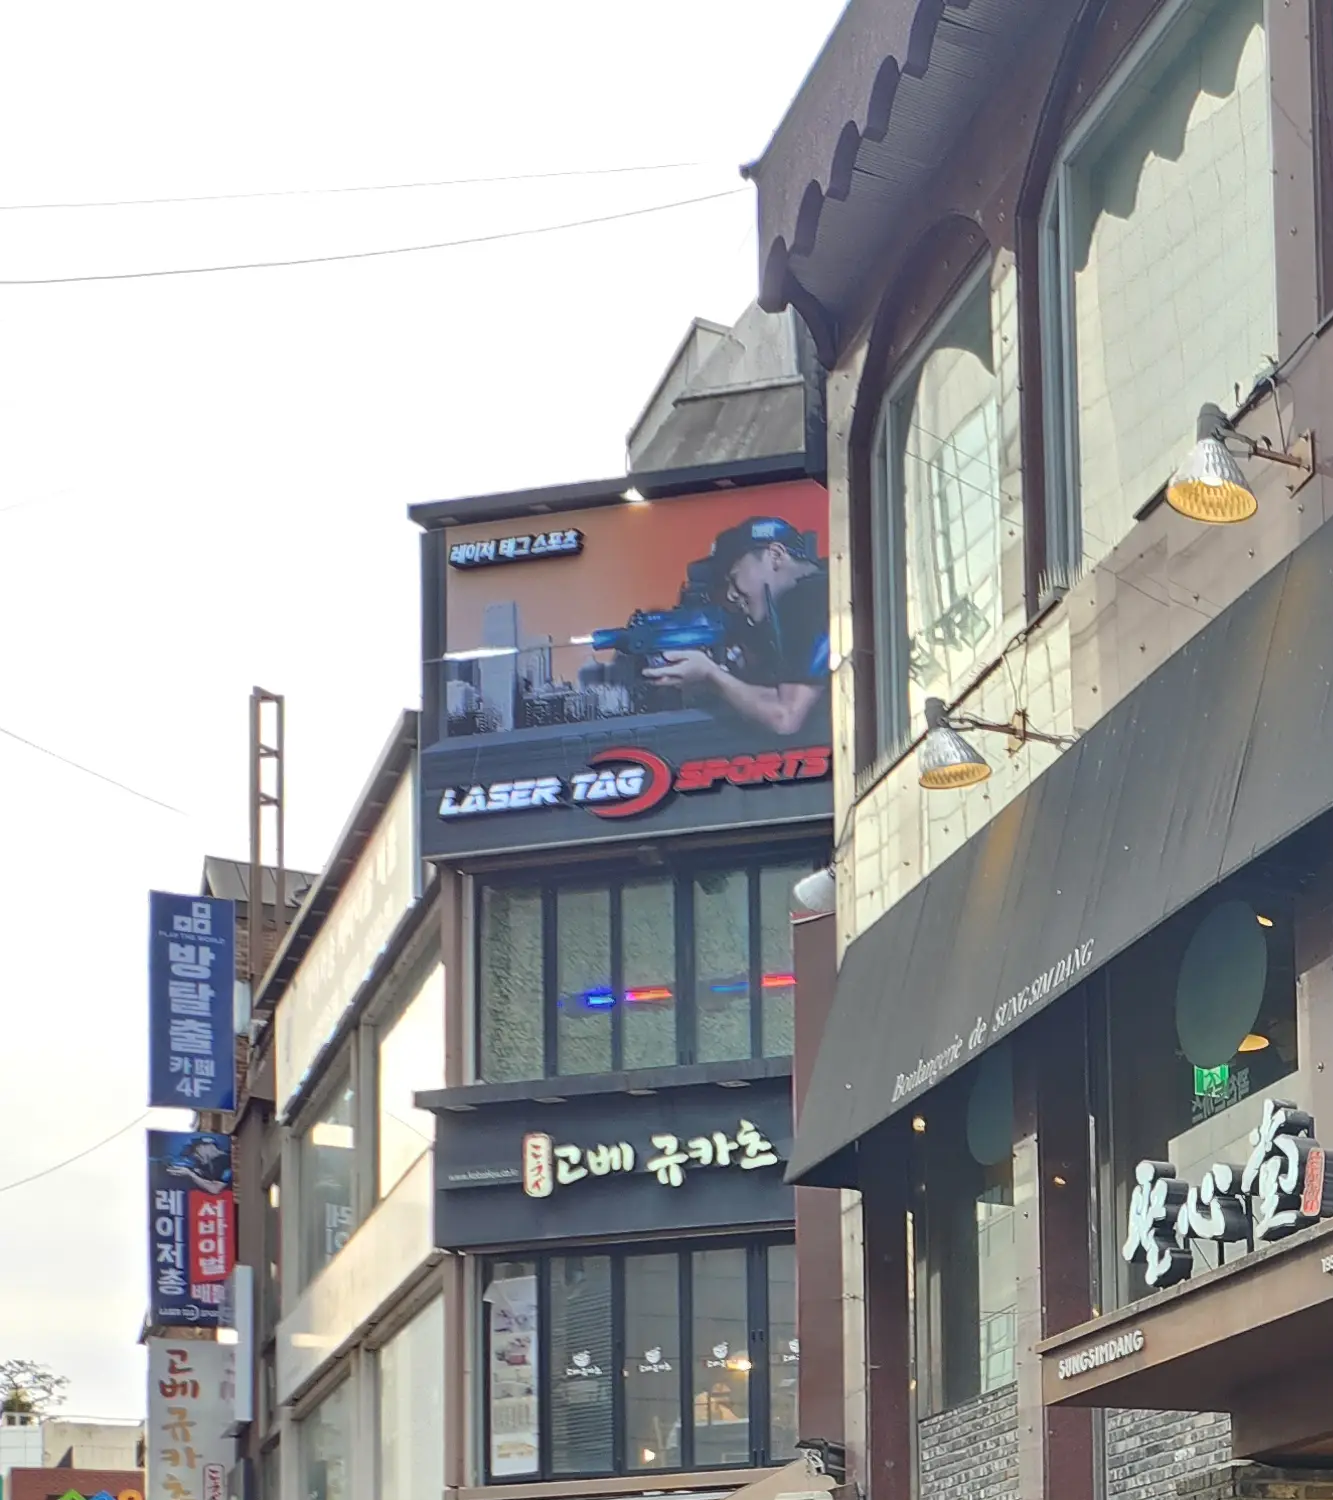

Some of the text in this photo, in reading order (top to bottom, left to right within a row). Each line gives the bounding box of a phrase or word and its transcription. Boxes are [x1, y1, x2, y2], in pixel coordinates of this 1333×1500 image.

[450, 530, 578, 564] 레이저 태그 스포츠
[438, 746, 832, 817] LASER TAG SPORTS
[168, 941, 215, 1056] 방탈출
[169, 1056, 215, 1078] 카페
[175, 1078, 214, 1099] 4F
[891, 1034, 964, 1103] Boulangerie
[967, 1016, 988, 1050] de
[552, 1141, 635, 1186] 고베
[646, 1119, 779, 1188] 규카츠
[155, 1188, 187, 1297] 레이저총
[158, 1348, 199, 1400] 고베
[1057, 1329, 1145, 1380] SUNGSIMDANG
